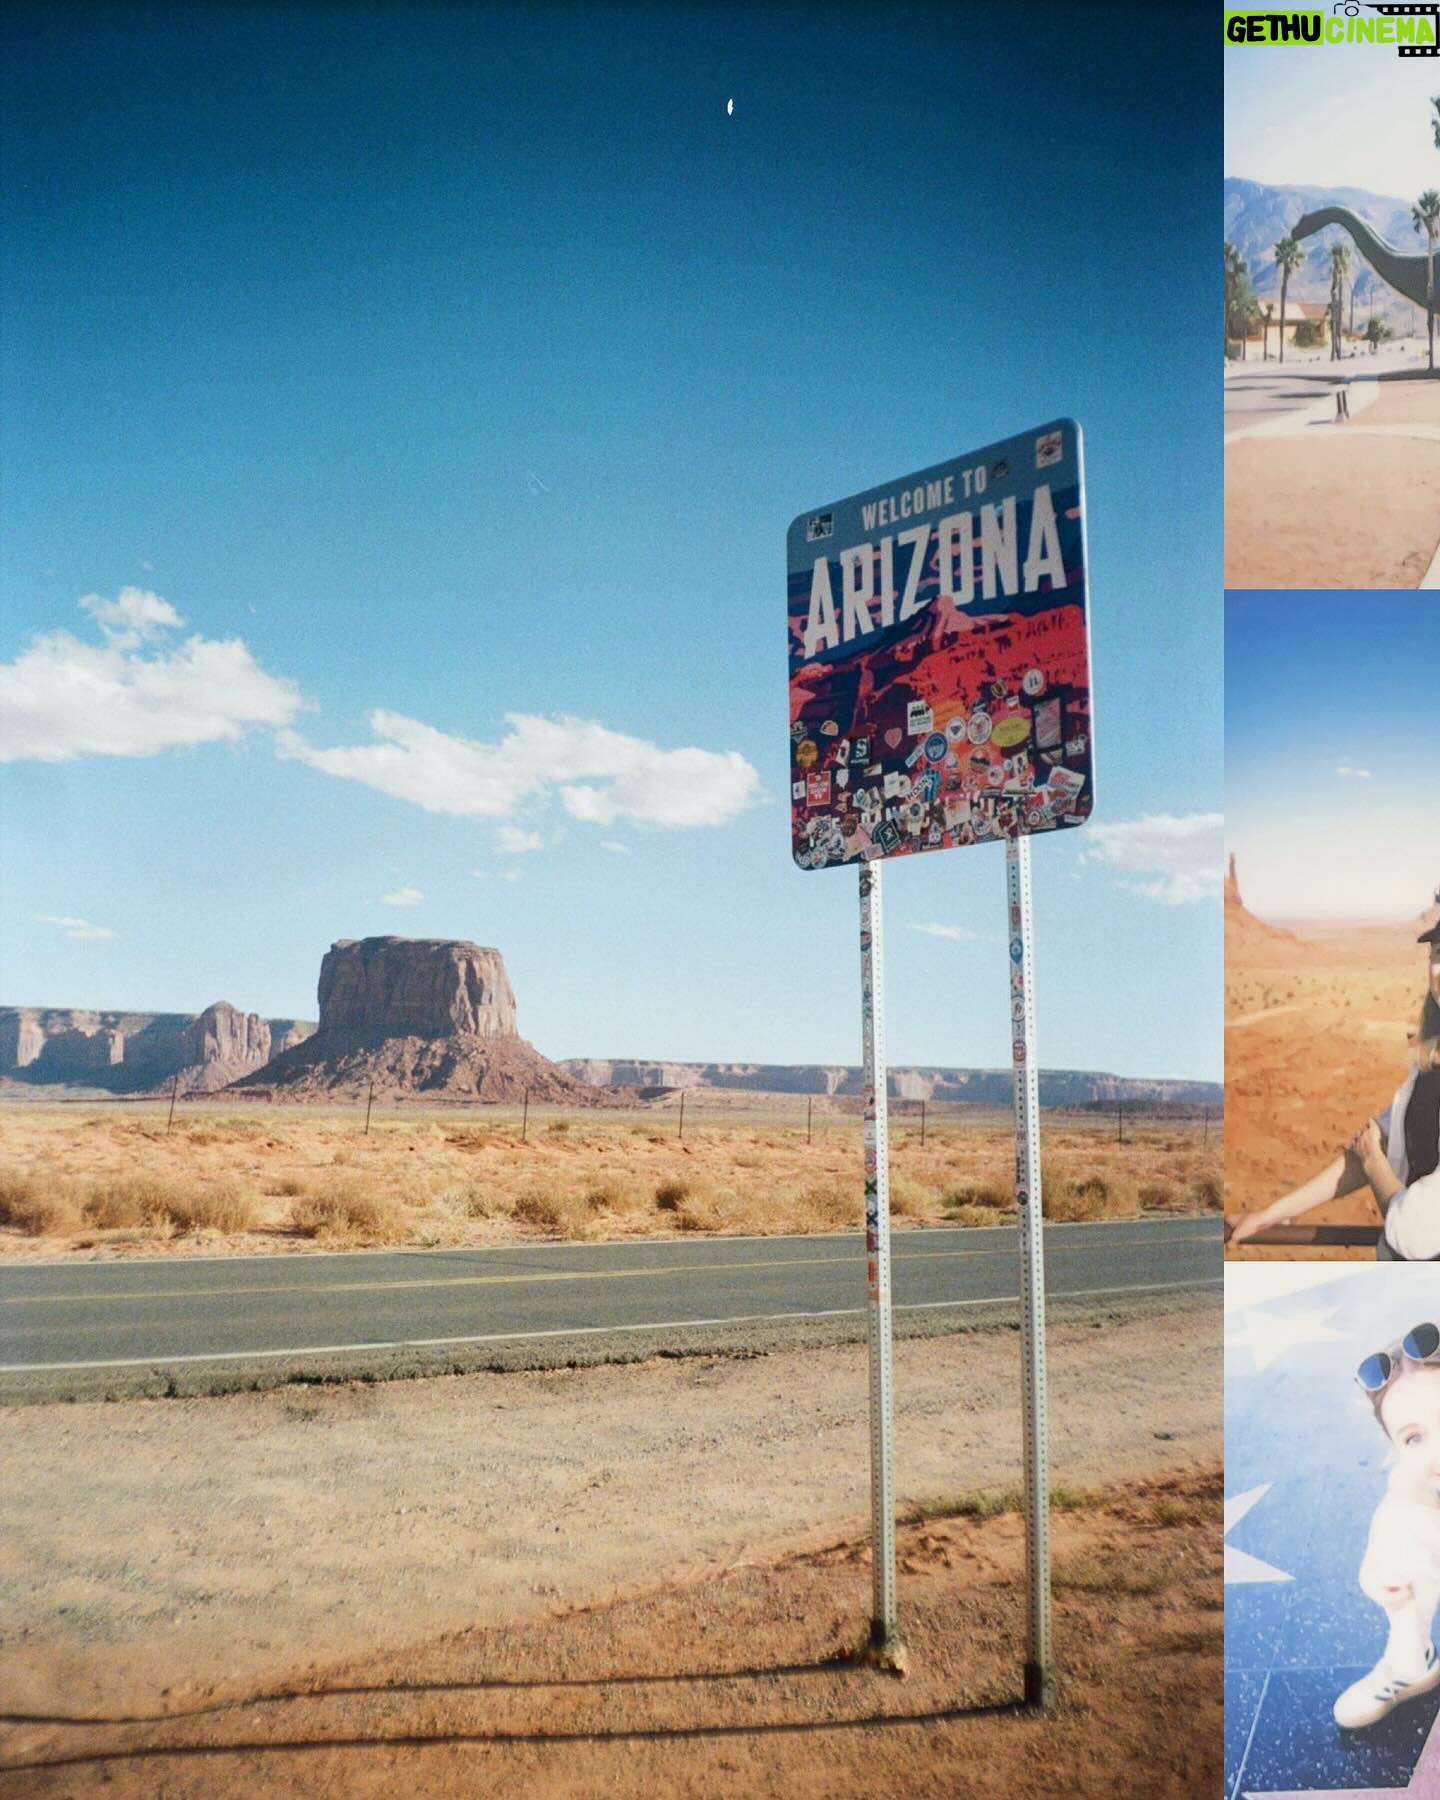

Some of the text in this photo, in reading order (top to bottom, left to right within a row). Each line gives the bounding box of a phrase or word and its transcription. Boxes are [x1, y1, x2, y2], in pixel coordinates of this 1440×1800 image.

[861, 465, 988, 531] WELCOME TO
[804, 485, 1067, 660] ARIZONA
